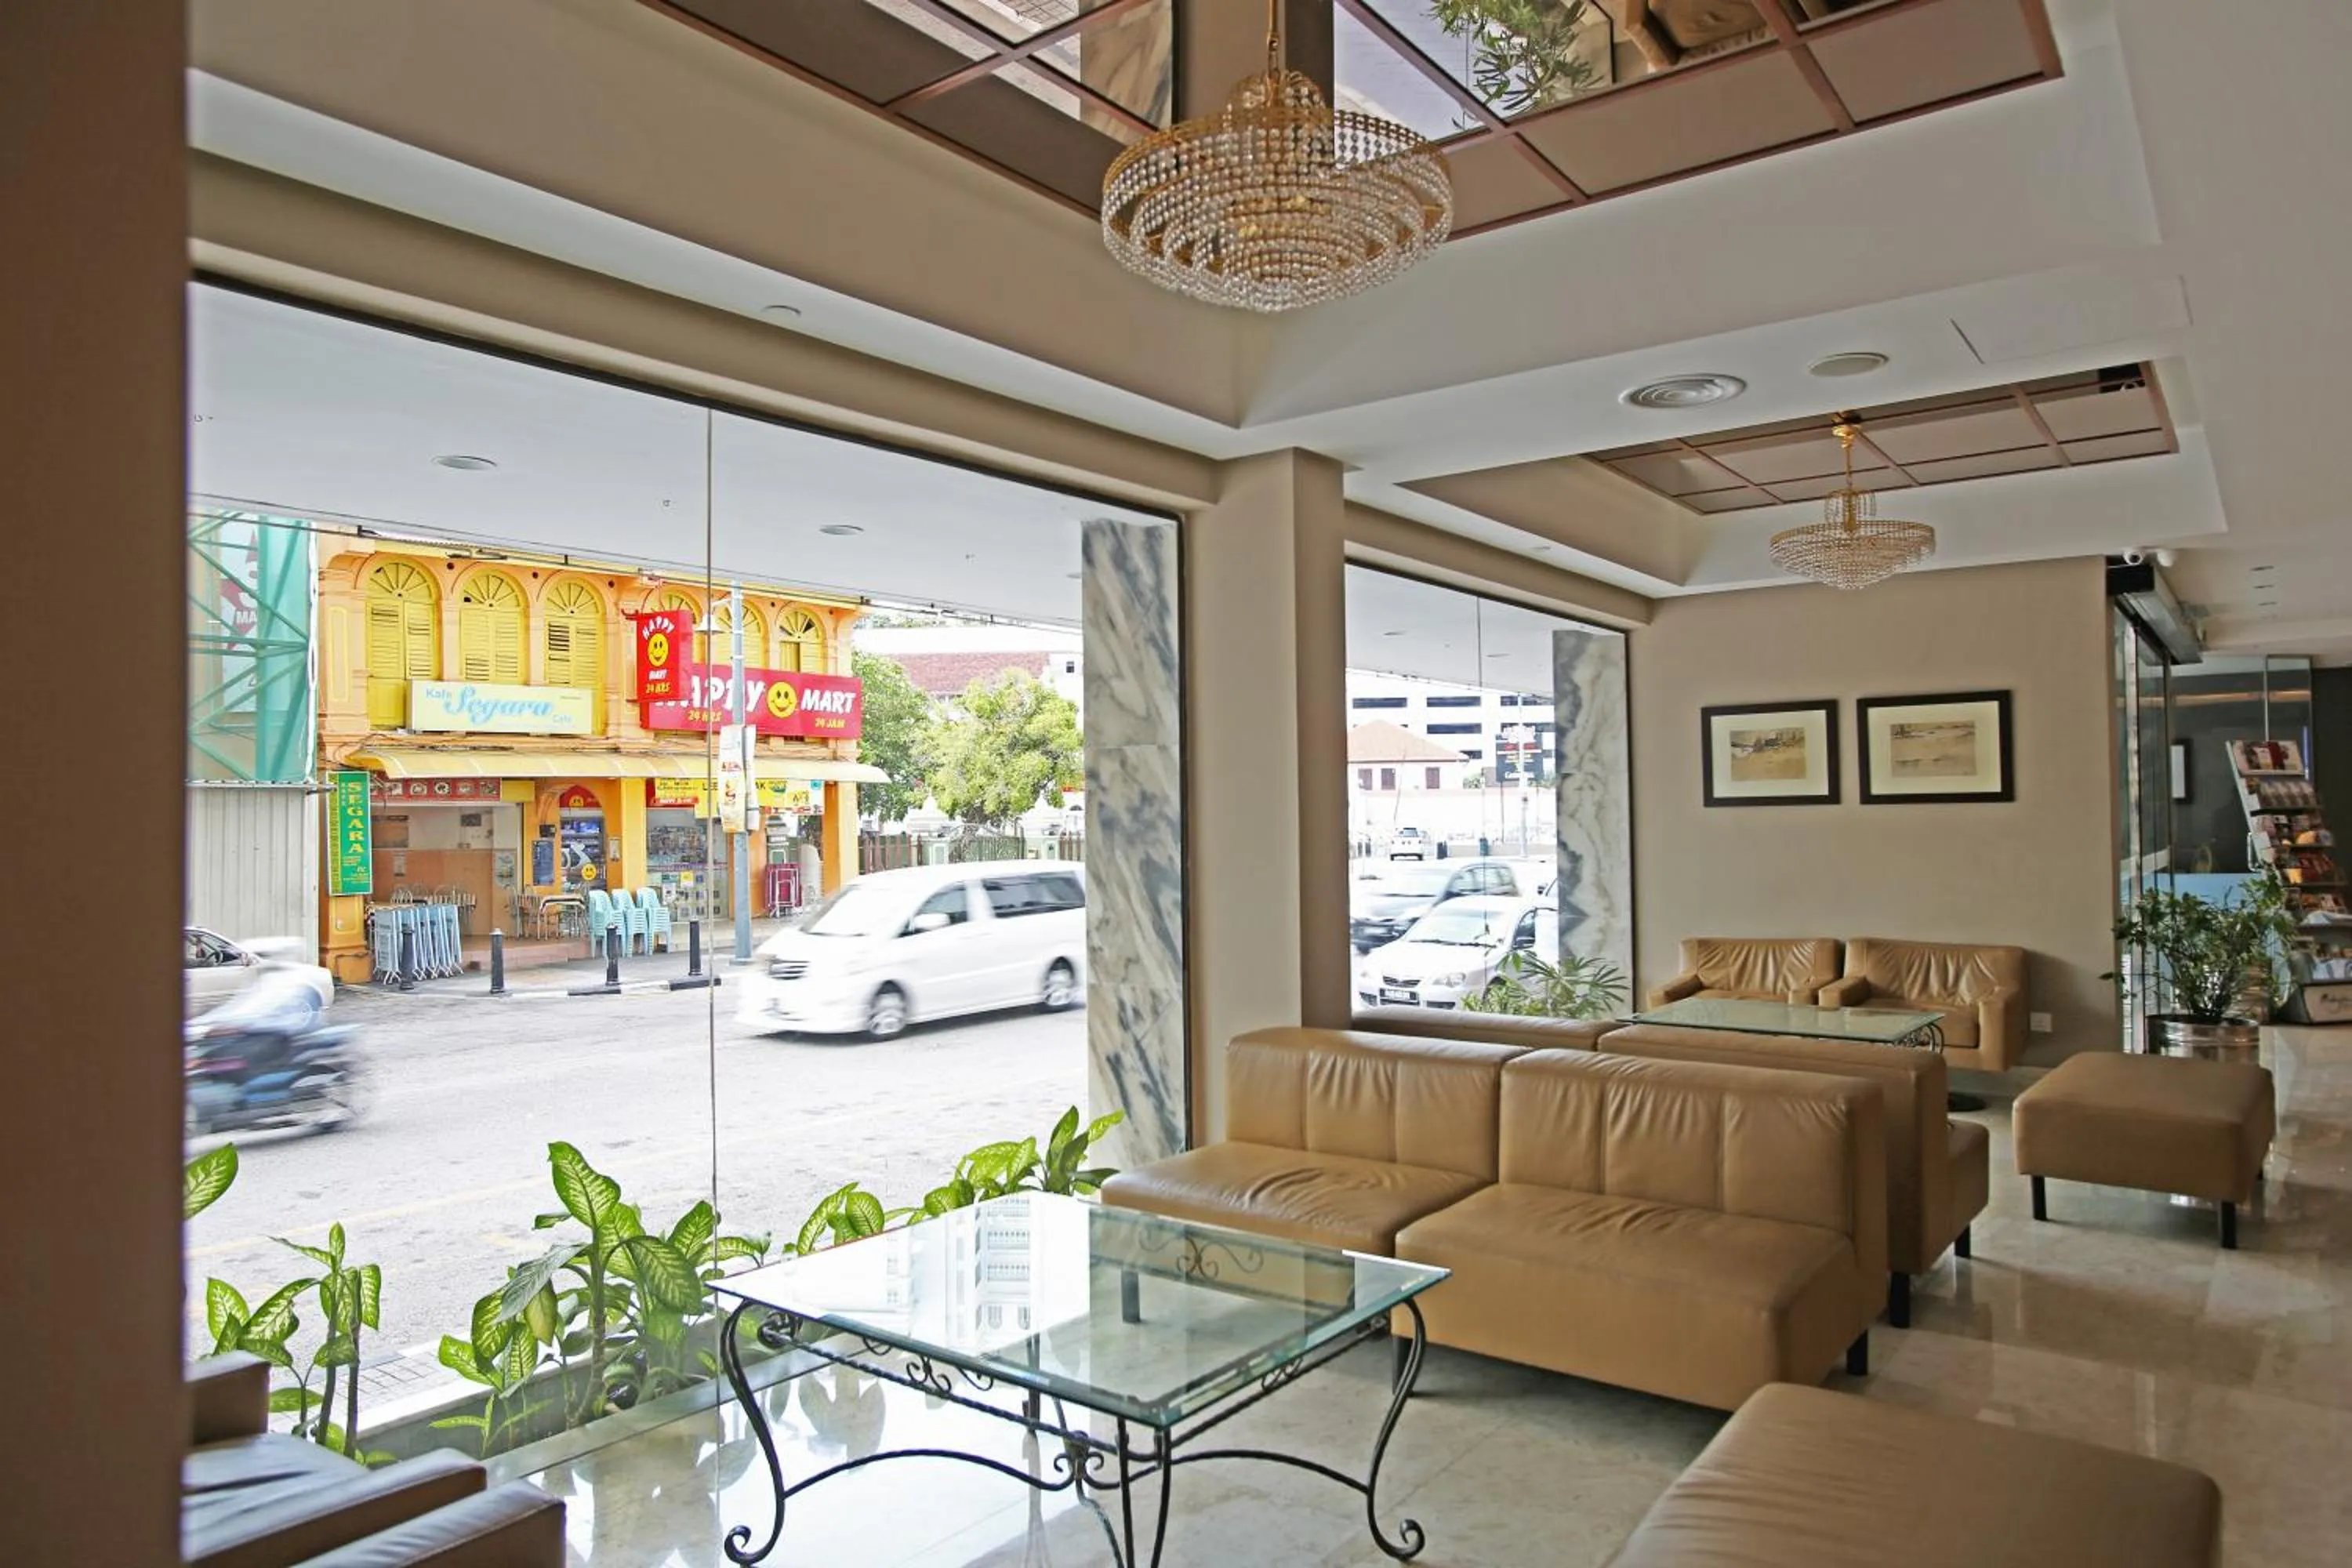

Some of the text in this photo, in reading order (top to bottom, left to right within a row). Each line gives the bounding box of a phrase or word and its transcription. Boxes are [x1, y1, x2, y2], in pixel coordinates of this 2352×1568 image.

[642, 615, 674, 640] HAPPY
[648, 669, 667, 681] MART
[800, 689, 855, 715] MART
[826, 717, 845, 729] JAM
[347, 782, 365, 852] SEGARA
